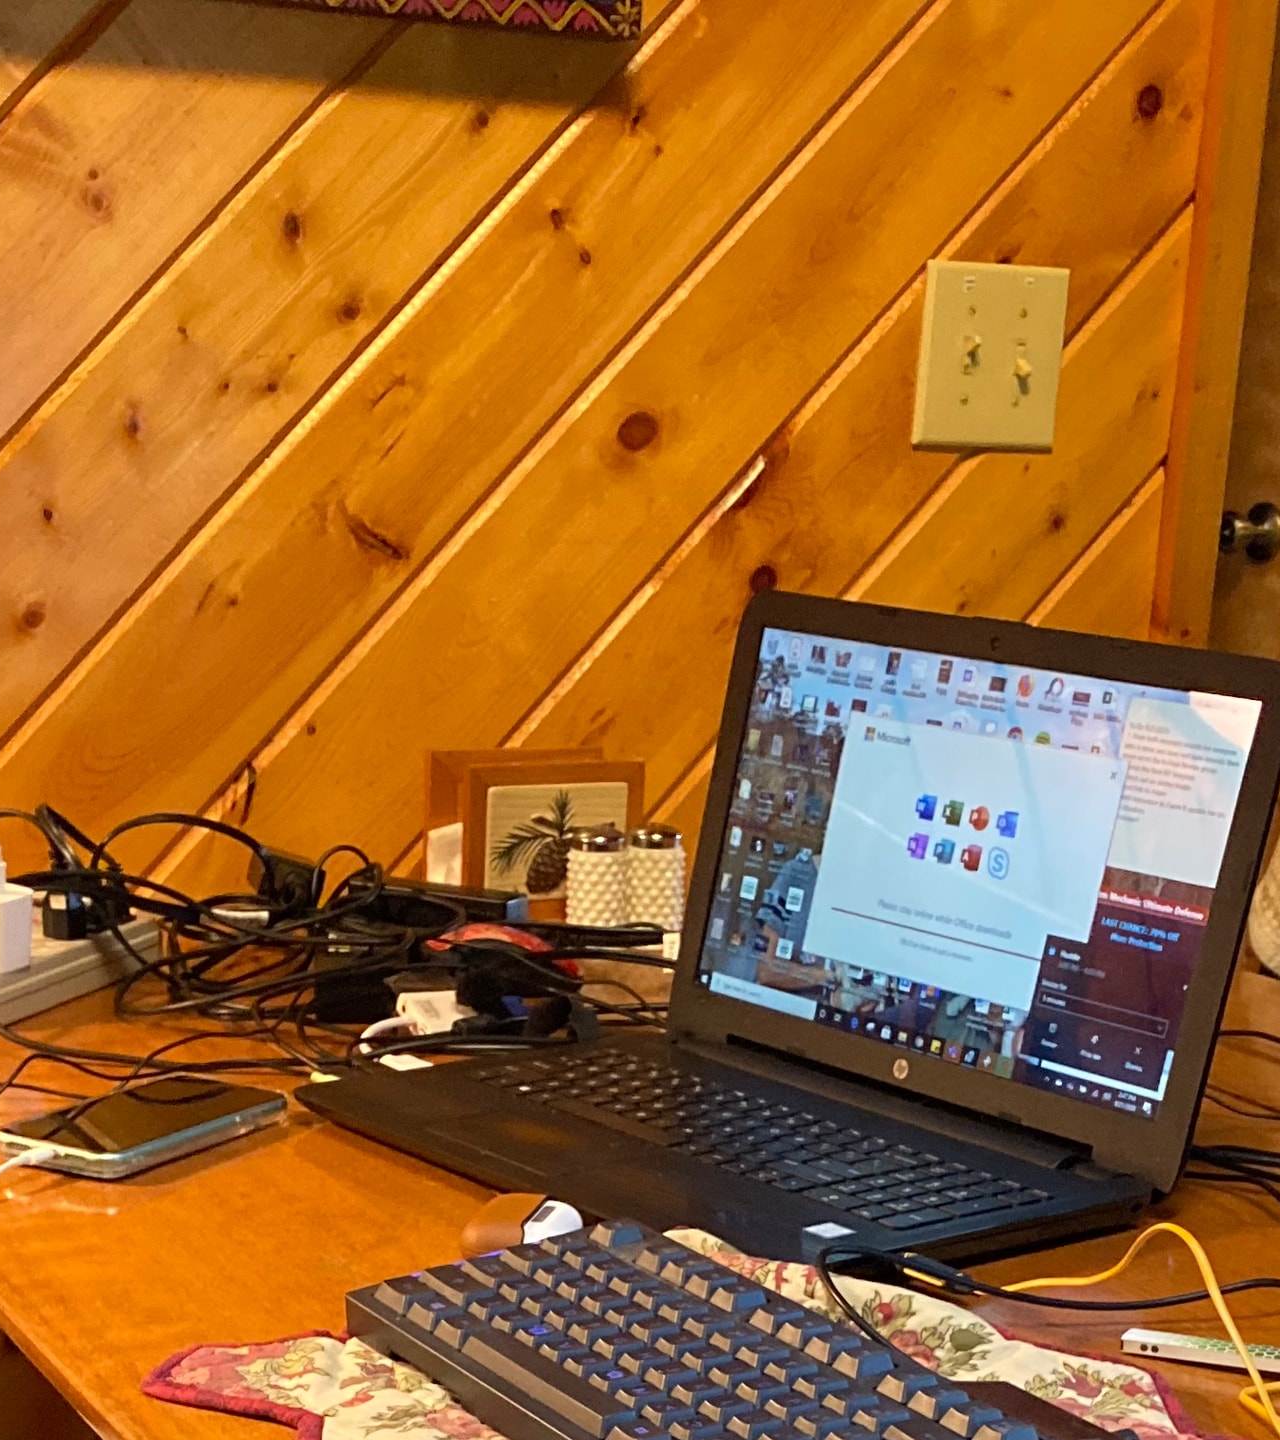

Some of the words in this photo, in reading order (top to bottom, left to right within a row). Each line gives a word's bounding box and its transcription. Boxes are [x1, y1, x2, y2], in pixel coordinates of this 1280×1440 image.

[877, 729, 911, 748] Microsoft
[1143, 899, 1173, 914] Ultimate
[1174, 906, 1204, 920] Defense
